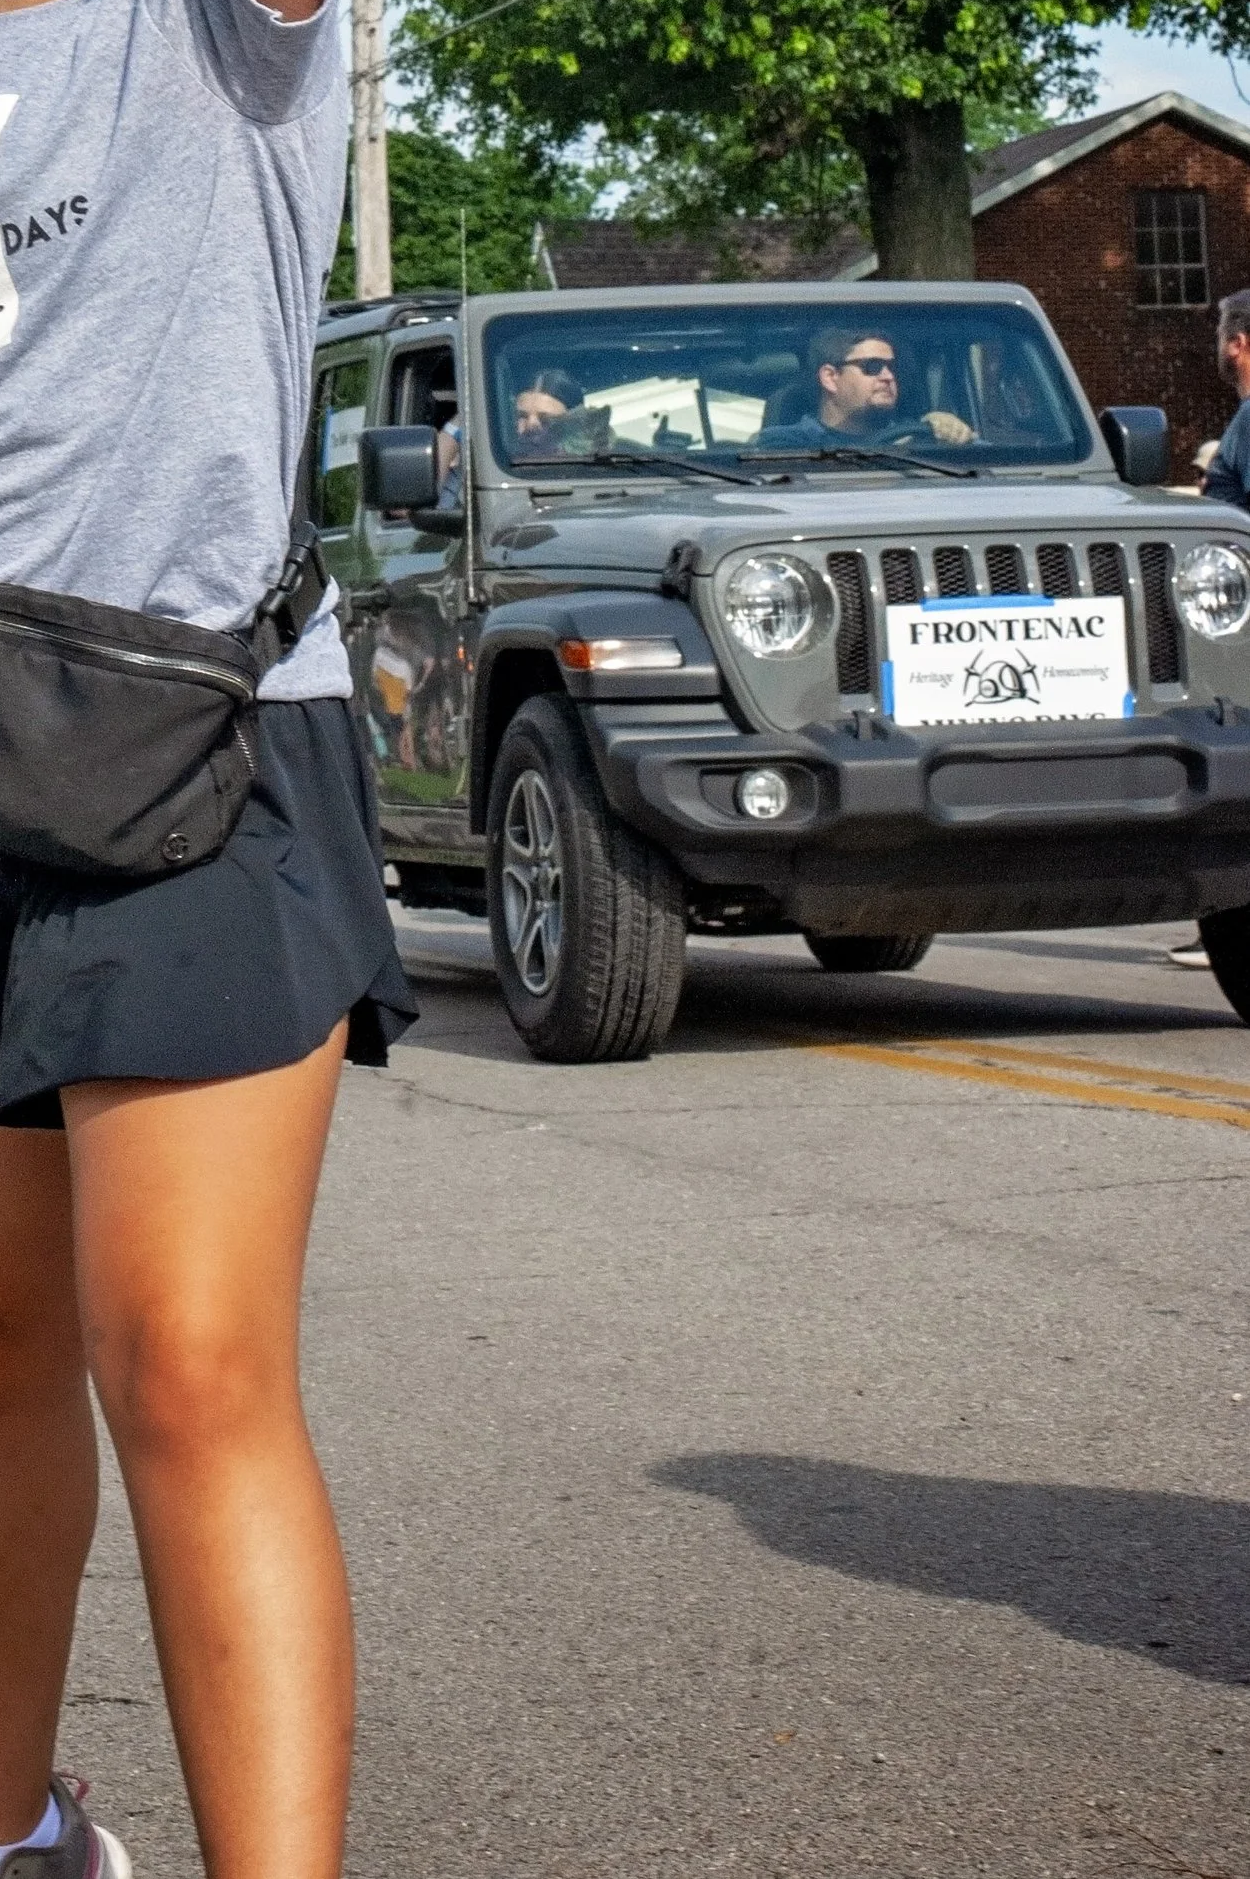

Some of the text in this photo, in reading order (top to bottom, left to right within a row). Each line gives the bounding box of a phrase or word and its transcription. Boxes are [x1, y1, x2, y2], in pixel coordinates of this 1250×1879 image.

[1, 195, 88, 256] DAYS
[909, 615, 1105, 645] FRONTENAC
[909, 671, 955, 688] Heritage
